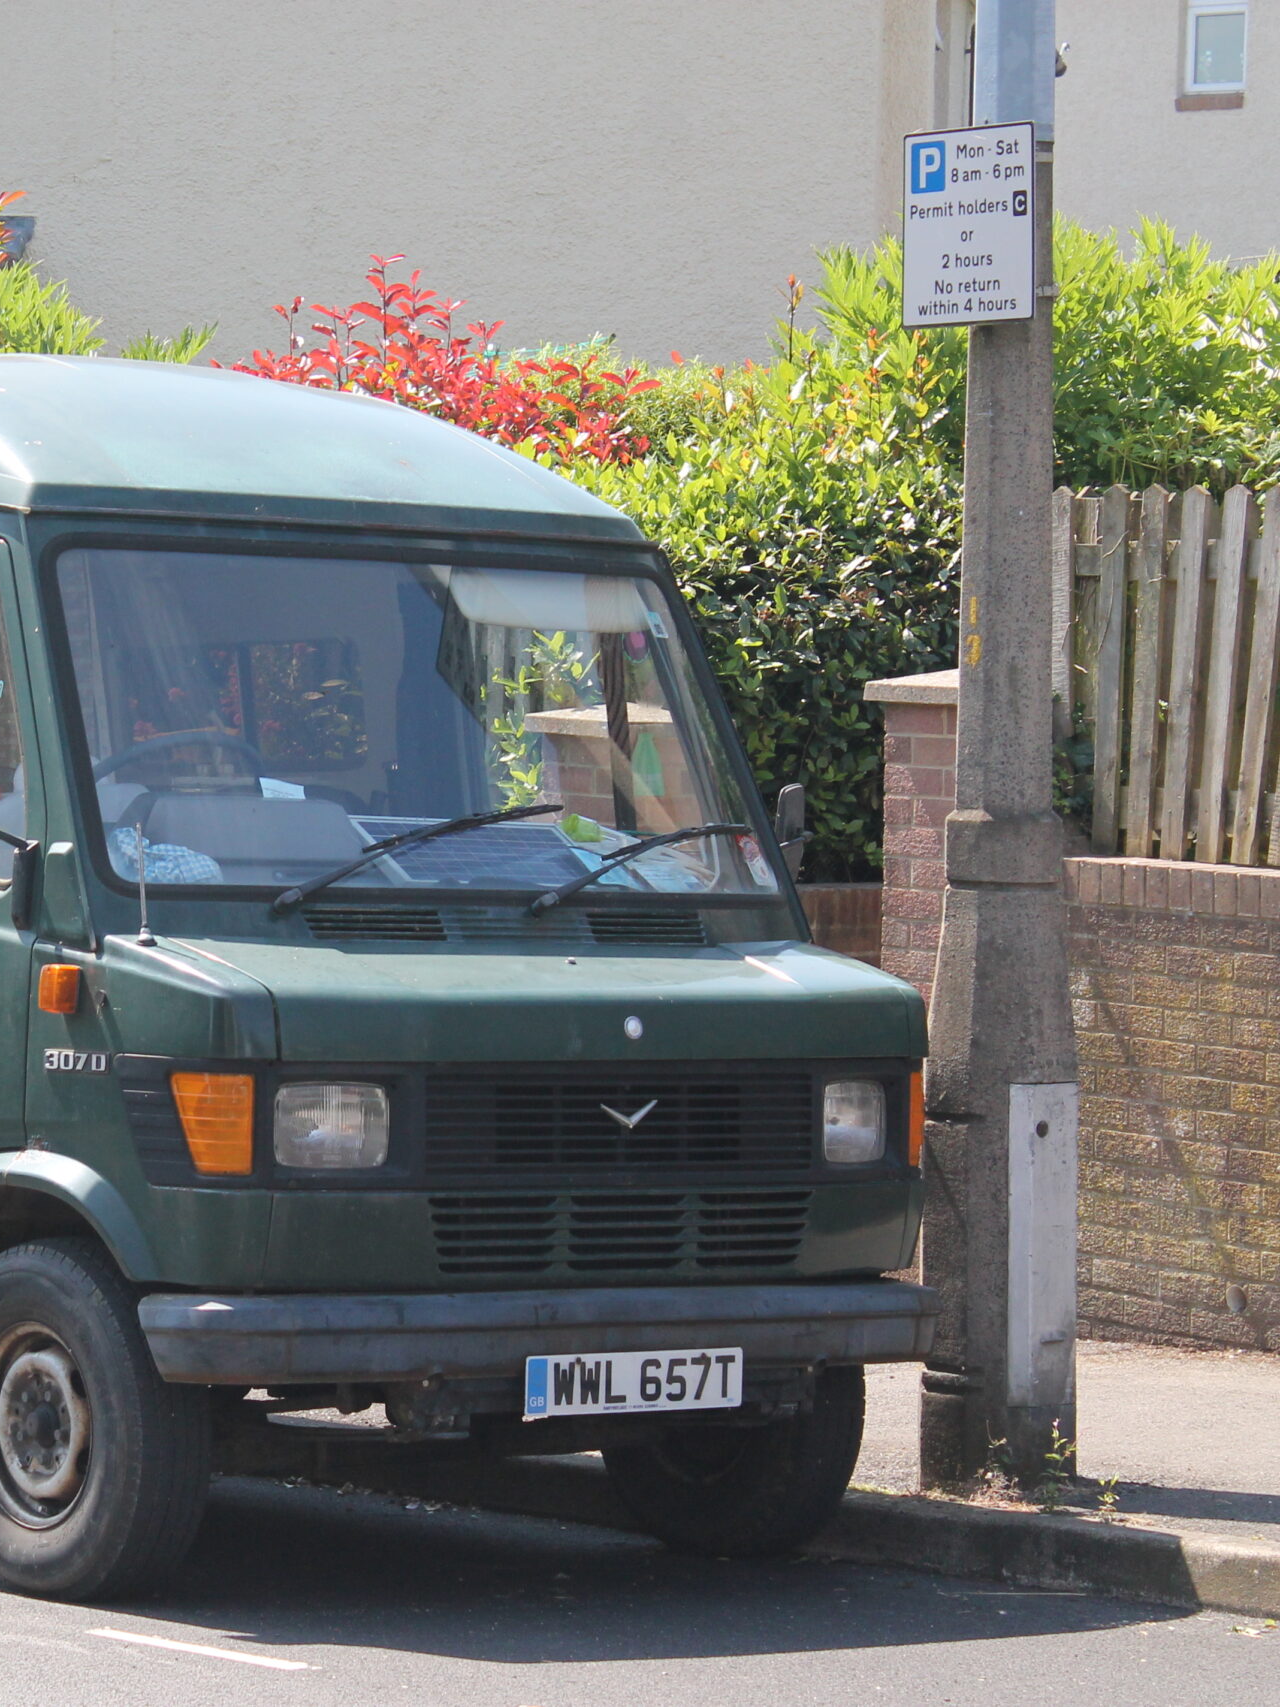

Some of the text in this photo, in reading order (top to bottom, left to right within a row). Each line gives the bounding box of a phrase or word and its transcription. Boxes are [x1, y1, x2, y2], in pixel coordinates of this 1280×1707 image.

[956, 144, 984, 159] Mon
[996, 139, 1019, 155] Sat
[919, 147, 941, 188] P
[951, 168, 959, 183] 8
[963, 170, 982, 182] am
[993, 164, 1001, 179] 6
[1004, 164, 1025, 182] pm
[910, 194, 1026, 220] Permit holders C
[960, 229, 974, 242] or
[941, 253, 993, 269] 2 hours
[934, 277, 1000, 295] No return
[918, 297, 1017, 316] within 4 hours
[554, 1355, 736, 1405] WWL 657T
[529, 1396, 545, 1408] GB
